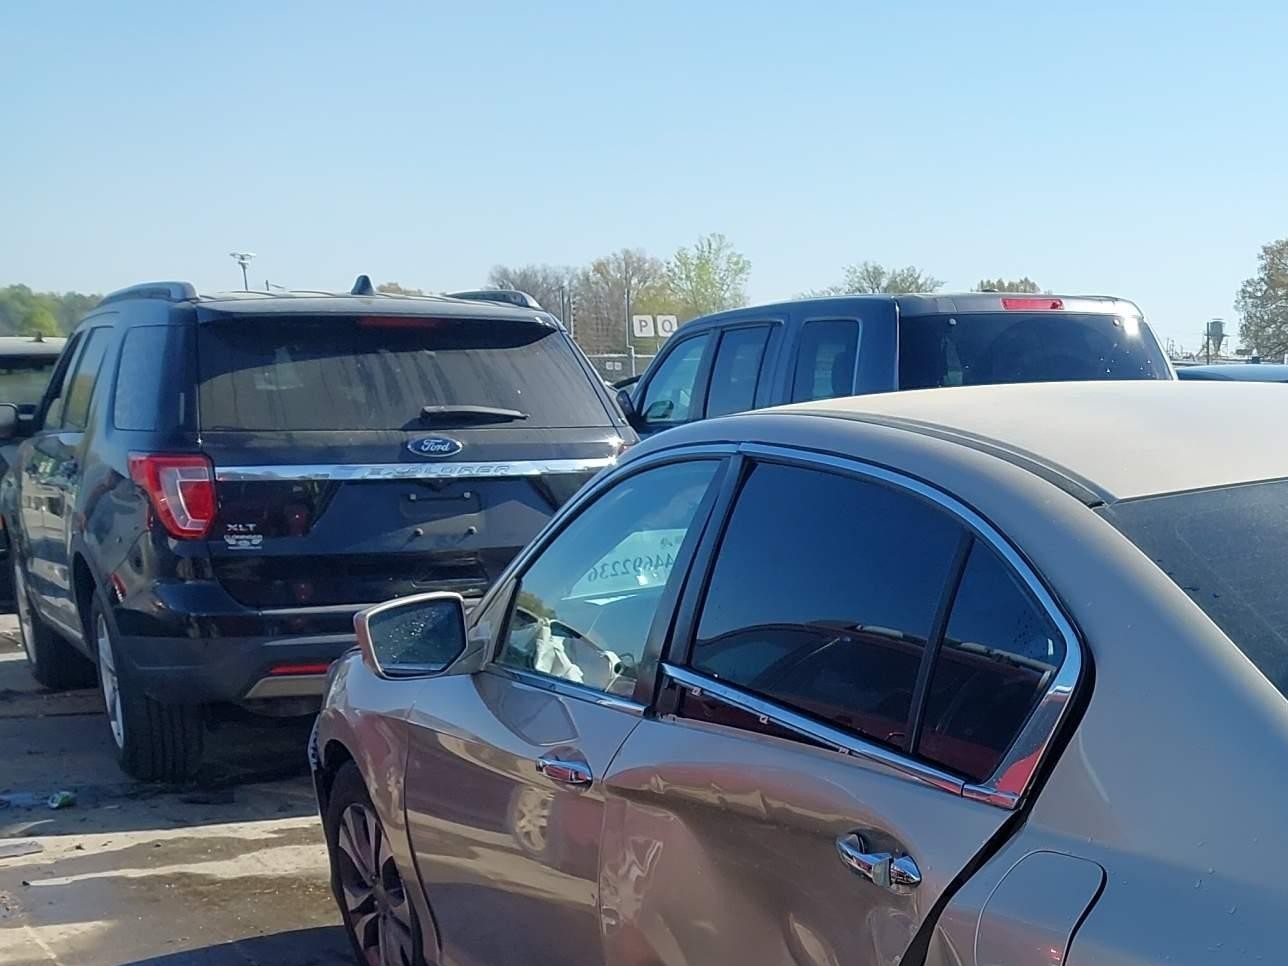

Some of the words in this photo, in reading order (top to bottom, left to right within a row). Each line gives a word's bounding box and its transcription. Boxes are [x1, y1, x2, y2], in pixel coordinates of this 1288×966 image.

[638, 319, 648, 333] P
[662, 319, 674, 333] Q
[421, 439, 450, 452] Ford
[367, 465, 510, 475] EXPLORER
[227, 523, 257, 531] XLT
